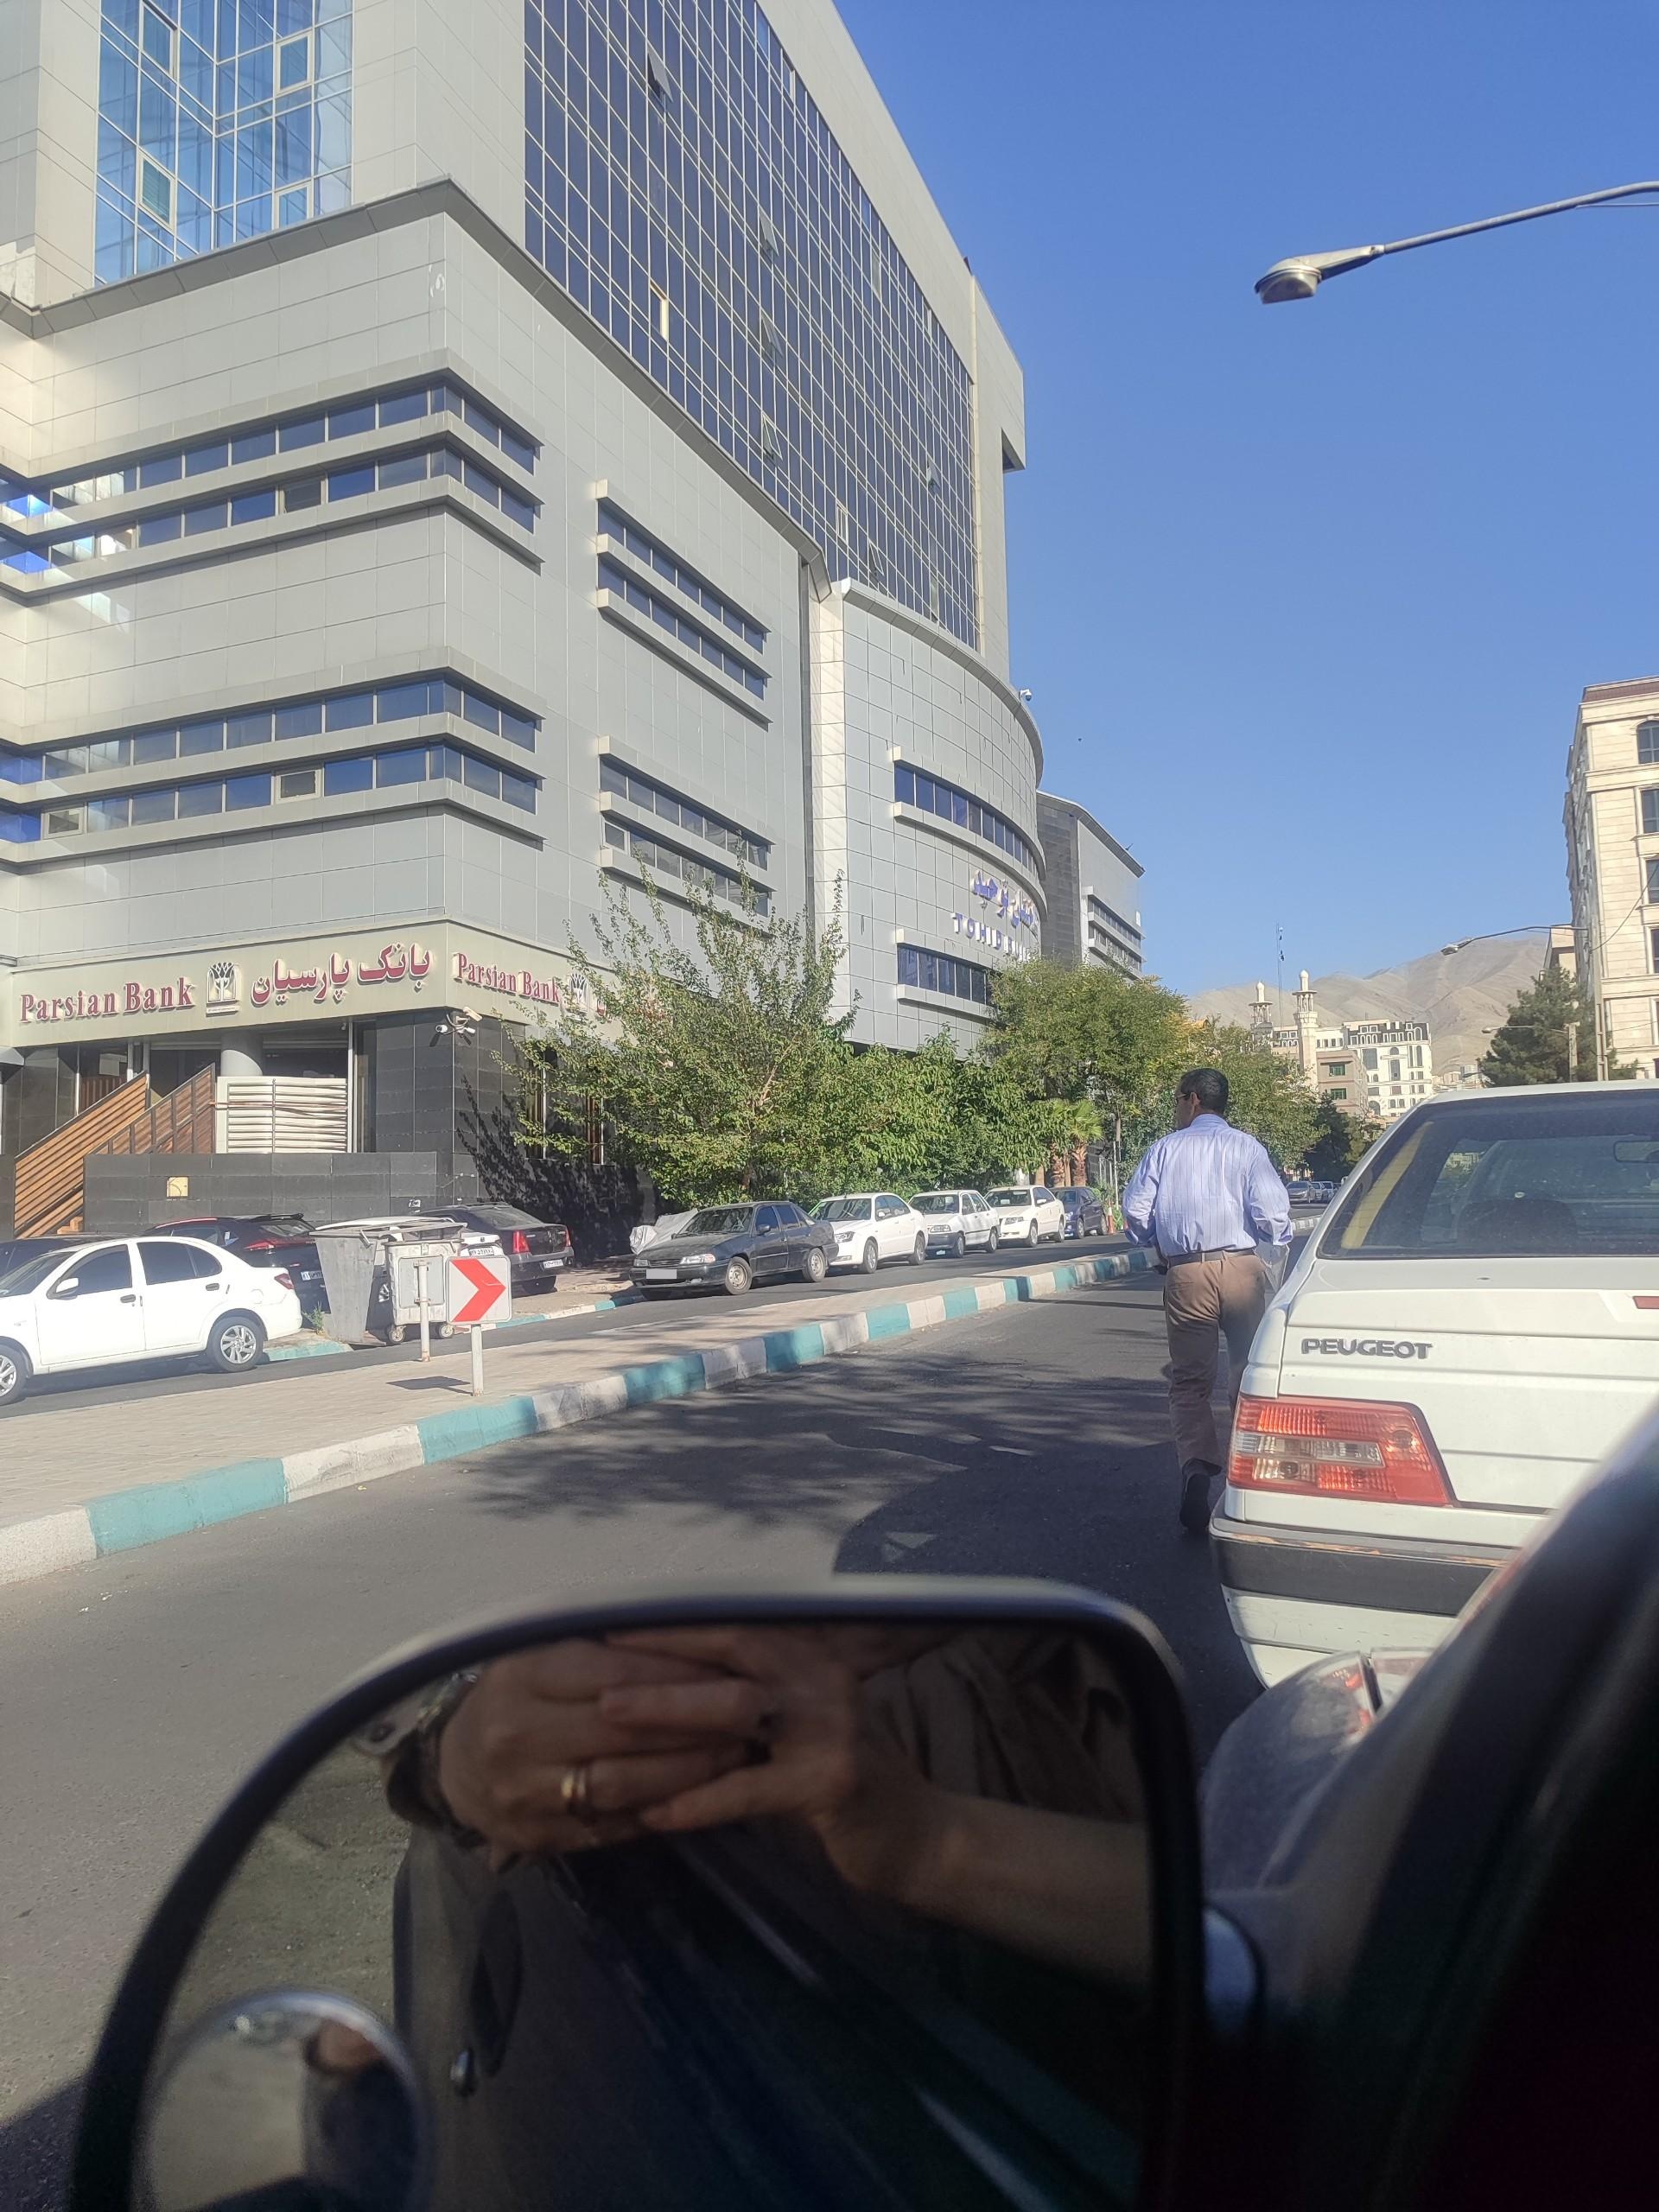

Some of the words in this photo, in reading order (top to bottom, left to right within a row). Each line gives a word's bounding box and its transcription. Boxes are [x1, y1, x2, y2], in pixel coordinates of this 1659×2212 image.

[951, 912, 1002, 950] TOHID
[251, 952, 351, 1004] پارسیان
[359, 943, 432, 990] بانک
[454, 952, 518, 995] Parsian
[520, 969, 561, 1006] Bank
[20, 990, 118, 1023] Parsian
[124, 976, 195, 1014] Bank
[1301, 1338, 1433, 1359] PEUGEOT
